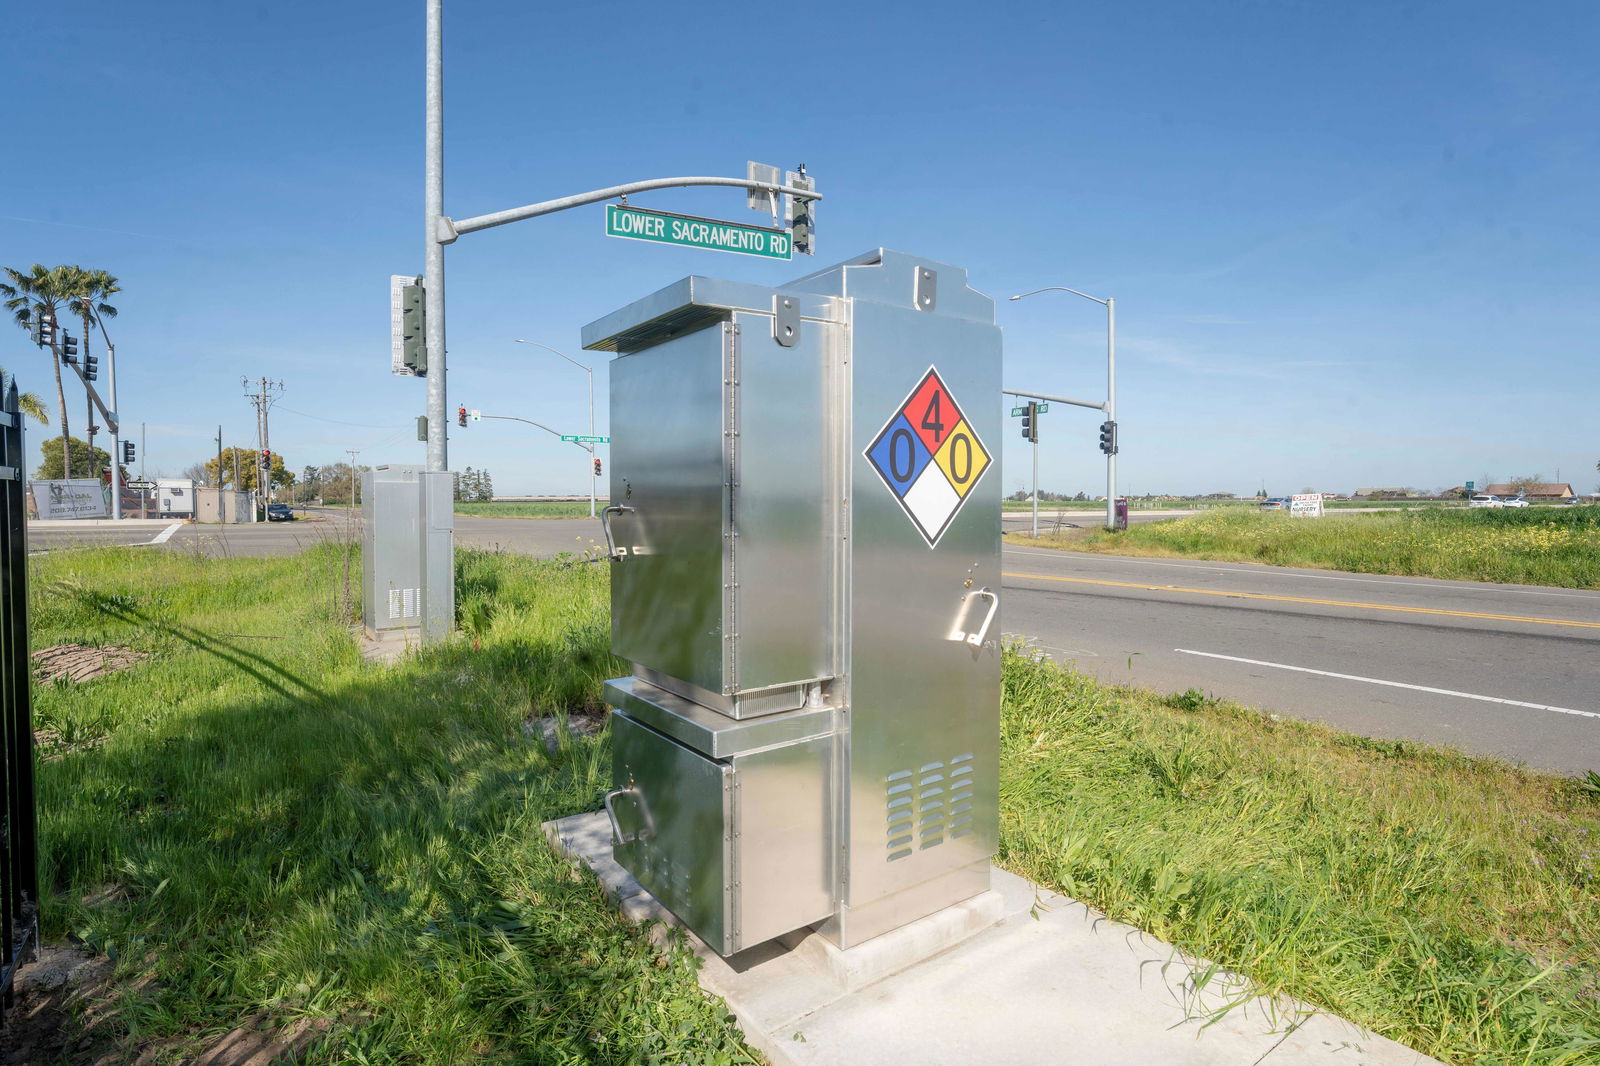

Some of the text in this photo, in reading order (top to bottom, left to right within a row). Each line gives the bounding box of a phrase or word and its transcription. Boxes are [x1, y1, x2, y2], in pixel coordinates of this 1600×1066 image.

[612, 211, 788, 254] LOWER SACRAMENTO RD
[921, 389, 944, 443] 4
[889, 428, 916, 483] 0
[949, 432, 972, 485] 0
